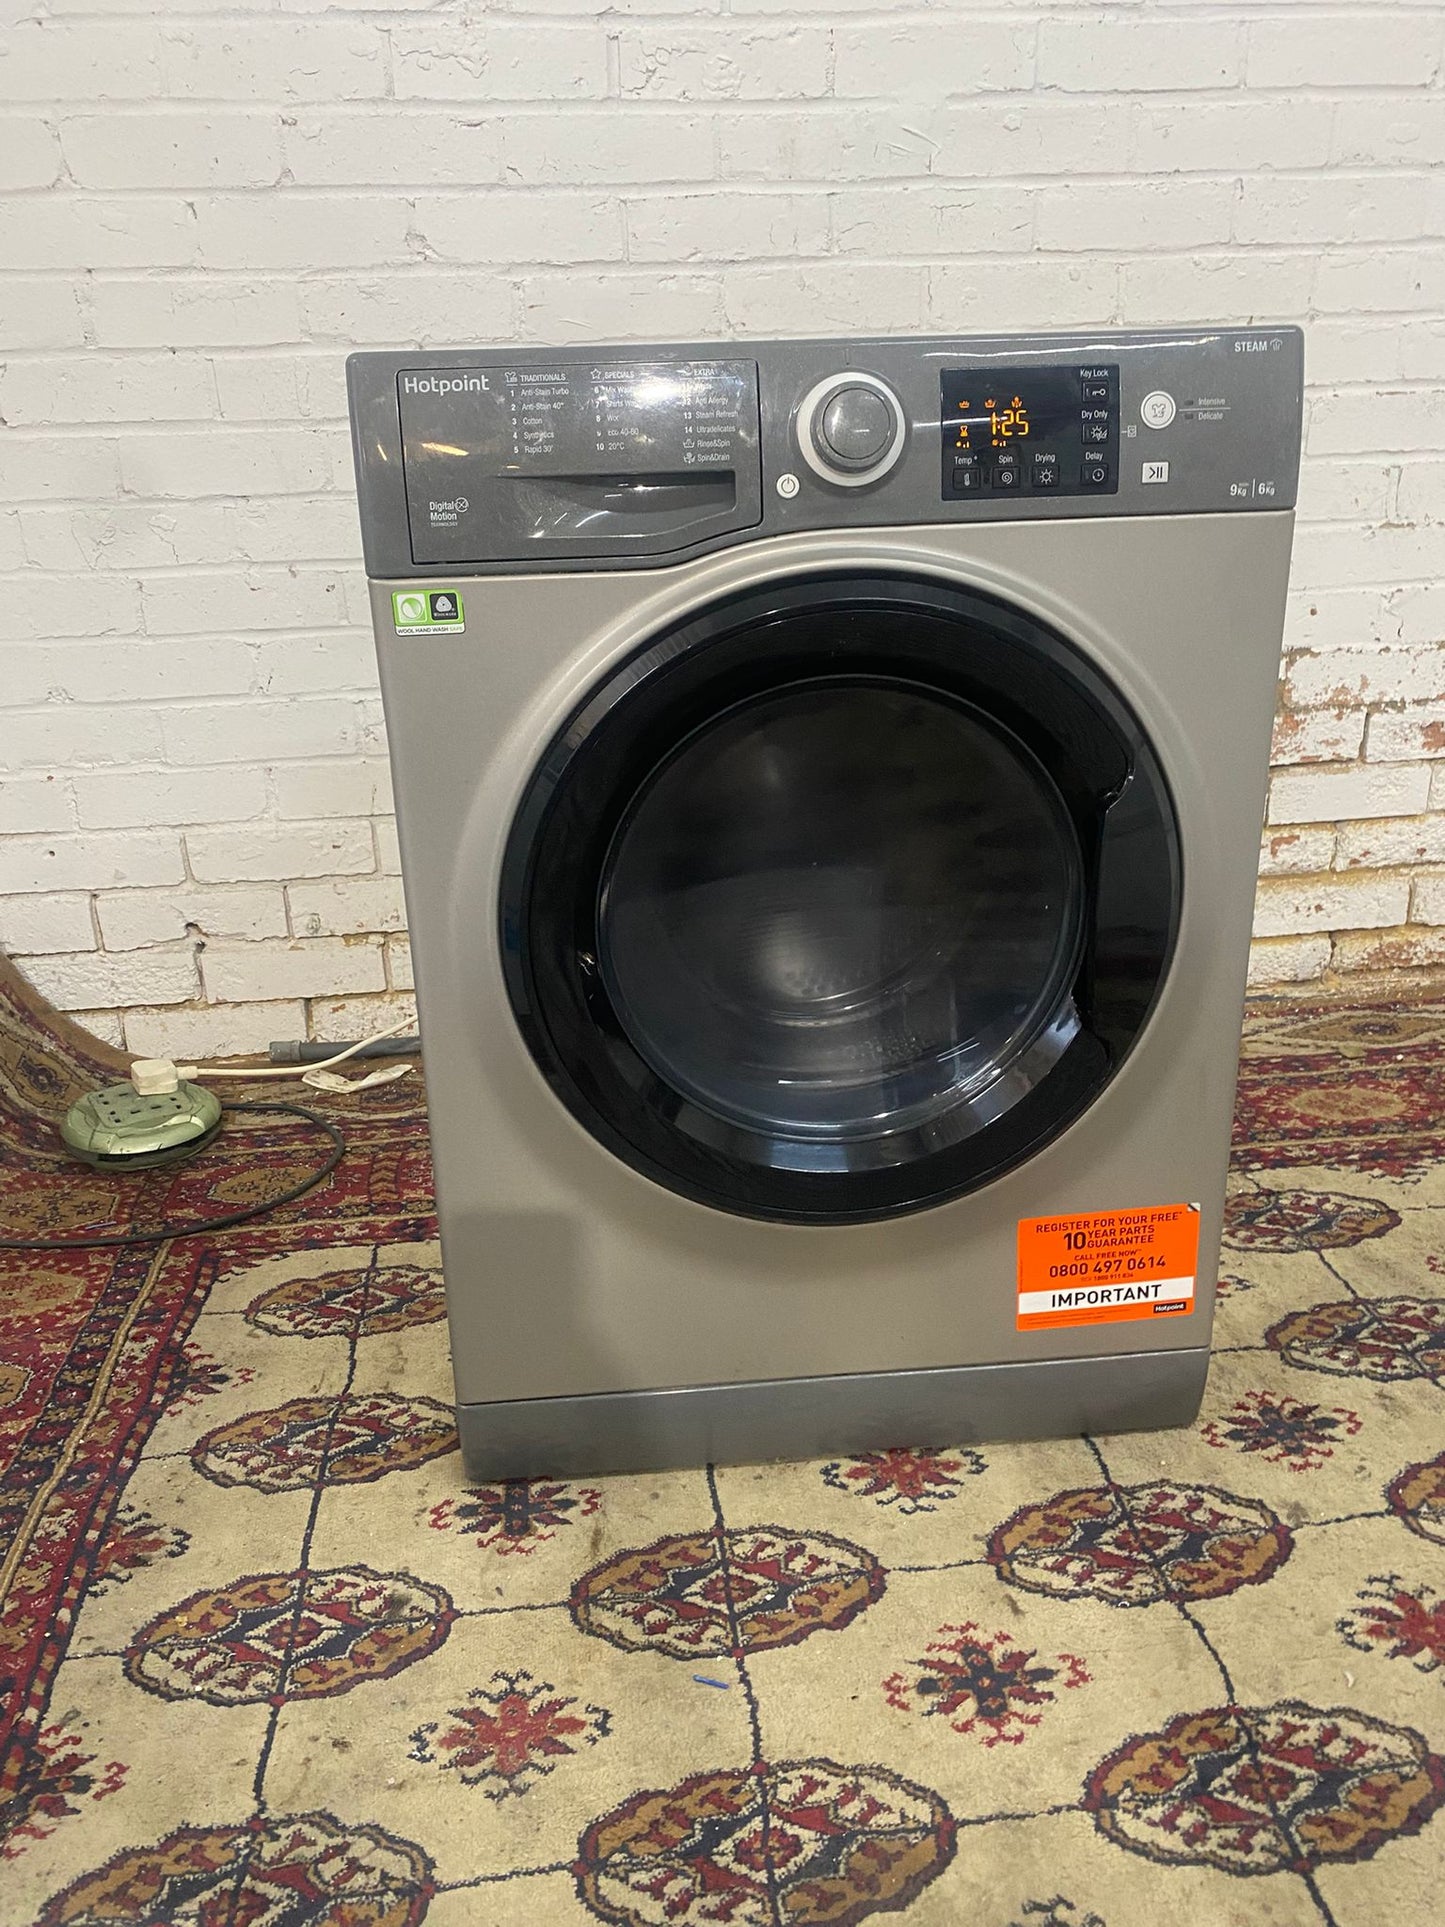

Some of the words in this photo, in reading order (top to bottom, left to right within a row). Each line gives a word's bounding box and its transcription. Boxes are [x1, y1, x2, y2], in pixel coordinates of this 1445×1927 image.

[1234, 341, 1267, 352] STEAM
[604, 371, 635, 379] SPECIALS
[694, 368, 715, 376] EXTRA
[1080, 369, 1092, 379] Key
[1093, 368, 1109, 377] Lock
[520, 373, 566, 382] TRADITIONALS
[404, 374, 490, 396] Hotpoint
[510, 389, 515, 397] 1
[521, 387, 551, 397] Anti-Stain
[552, 387, 570, 395] Turbo
[511, 403, 516, 411] 2
[521, 402, 551, 411] Anti-Stain
[595, 400, 600, 408] 7
[1199, 397, 1226, 406] Intensive
[595, 414, 601, 422] 8
[683, 411, 692, 419] 13
[695, 410, 714, 419] Steam
[716, 410, 739, 419] Refresh
[1081, 410, 1093, 420] Dry
[1094, 409, 1108, 420] Only
[1199, 411, 1224, 421] Delicate
[512, 417, 517, 426] 3
[522, 416, 543, 425] Cotton
[621, 427, 639, 437] 40-60
[684, 425, 693, 433] 14
[696, 425, 736, 433] Ultradelicates
[513, 432, 518, 440] 4
[523, 431, 555, 441] Synthetics
[596, 442, 605, 451] 10
[608, 441, 625, 451] 20°C
[696, 439, 731, 448] Rinse&Spin
[514, 446, 519, 454] 5
[524, 445, 542, 455] Rapid
[697, 453, 730, 463] Spin&Drain
[954, 455, 972, 466] Temp
[998, 455, 1013, 464] Spin
[1035, 453, 1056, 464] Drying
[1085, 451, 1104, 462] Delay
[430, 501, 454, 512] Digital
[430, 512, 457, 520] Motion
[1036, 1220, 1090, 1233] REGISTER
[1093, 1217, 1115, 1228] FOR
[1118, 1215, 1147, 1226] YOUR
[1063, 1231, 1087, 1250] 10
[1087, 1228, 1116, 1239] YEAR
[1119, 1224, 1155, 1236] PARTS
[1087, 1234, 1155, 1248] GUARANTEE
[1074, 1253, 1095, 1261] CALL
[1096, 1250, 1117, 1259] FREE
[1049, 1263, 1088, 1278] 0800
[1092, 1259, 1122, 1274] 497
[1127, 1255, 1166, 1271] 0614
[1051, 1284, 1162, 1308] IMPORTANT
[1155, 1302, 1185, 1312] Hotpoint
